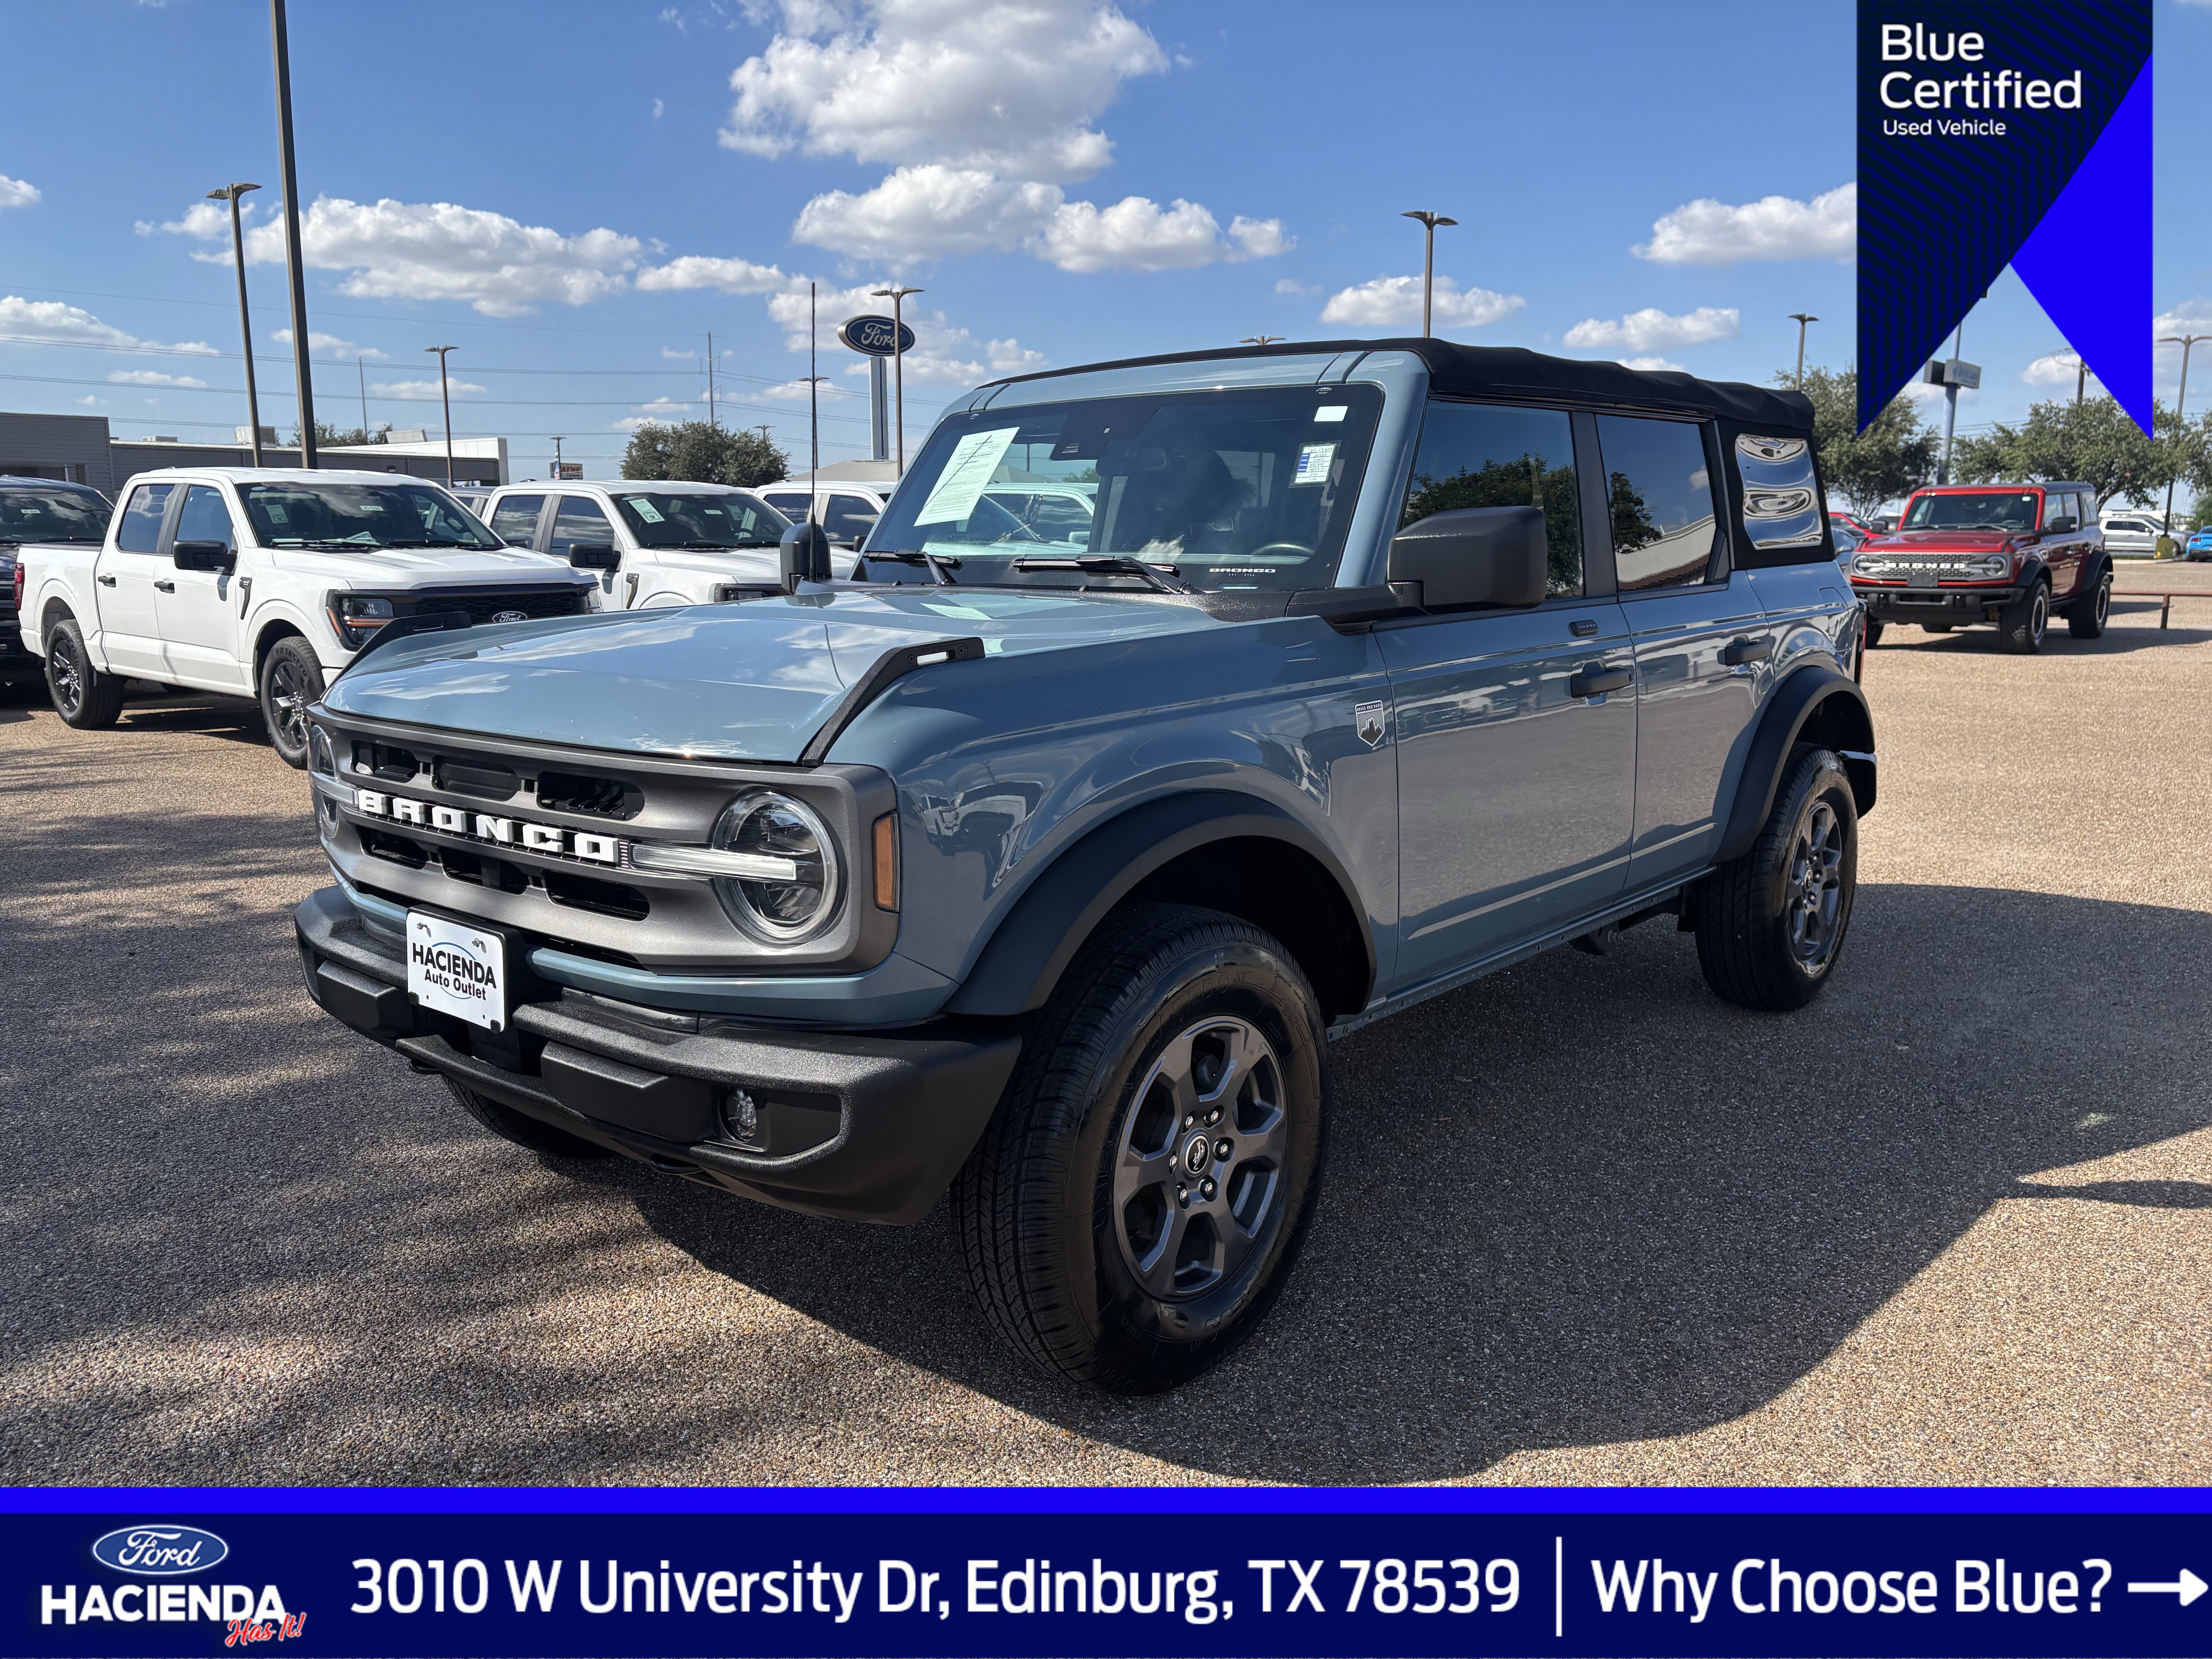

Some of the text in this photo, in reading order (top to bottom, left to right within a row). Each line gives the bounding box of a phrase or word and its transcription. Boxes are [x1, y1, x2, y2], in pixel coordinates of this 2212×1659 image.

[499, 613, 521, 622] Ford
[357, 789, 620, 863] BRONCO
[412, 942, 497, 989] HACIENDA
[424, 969, 486, 1001] Auto Outlet
